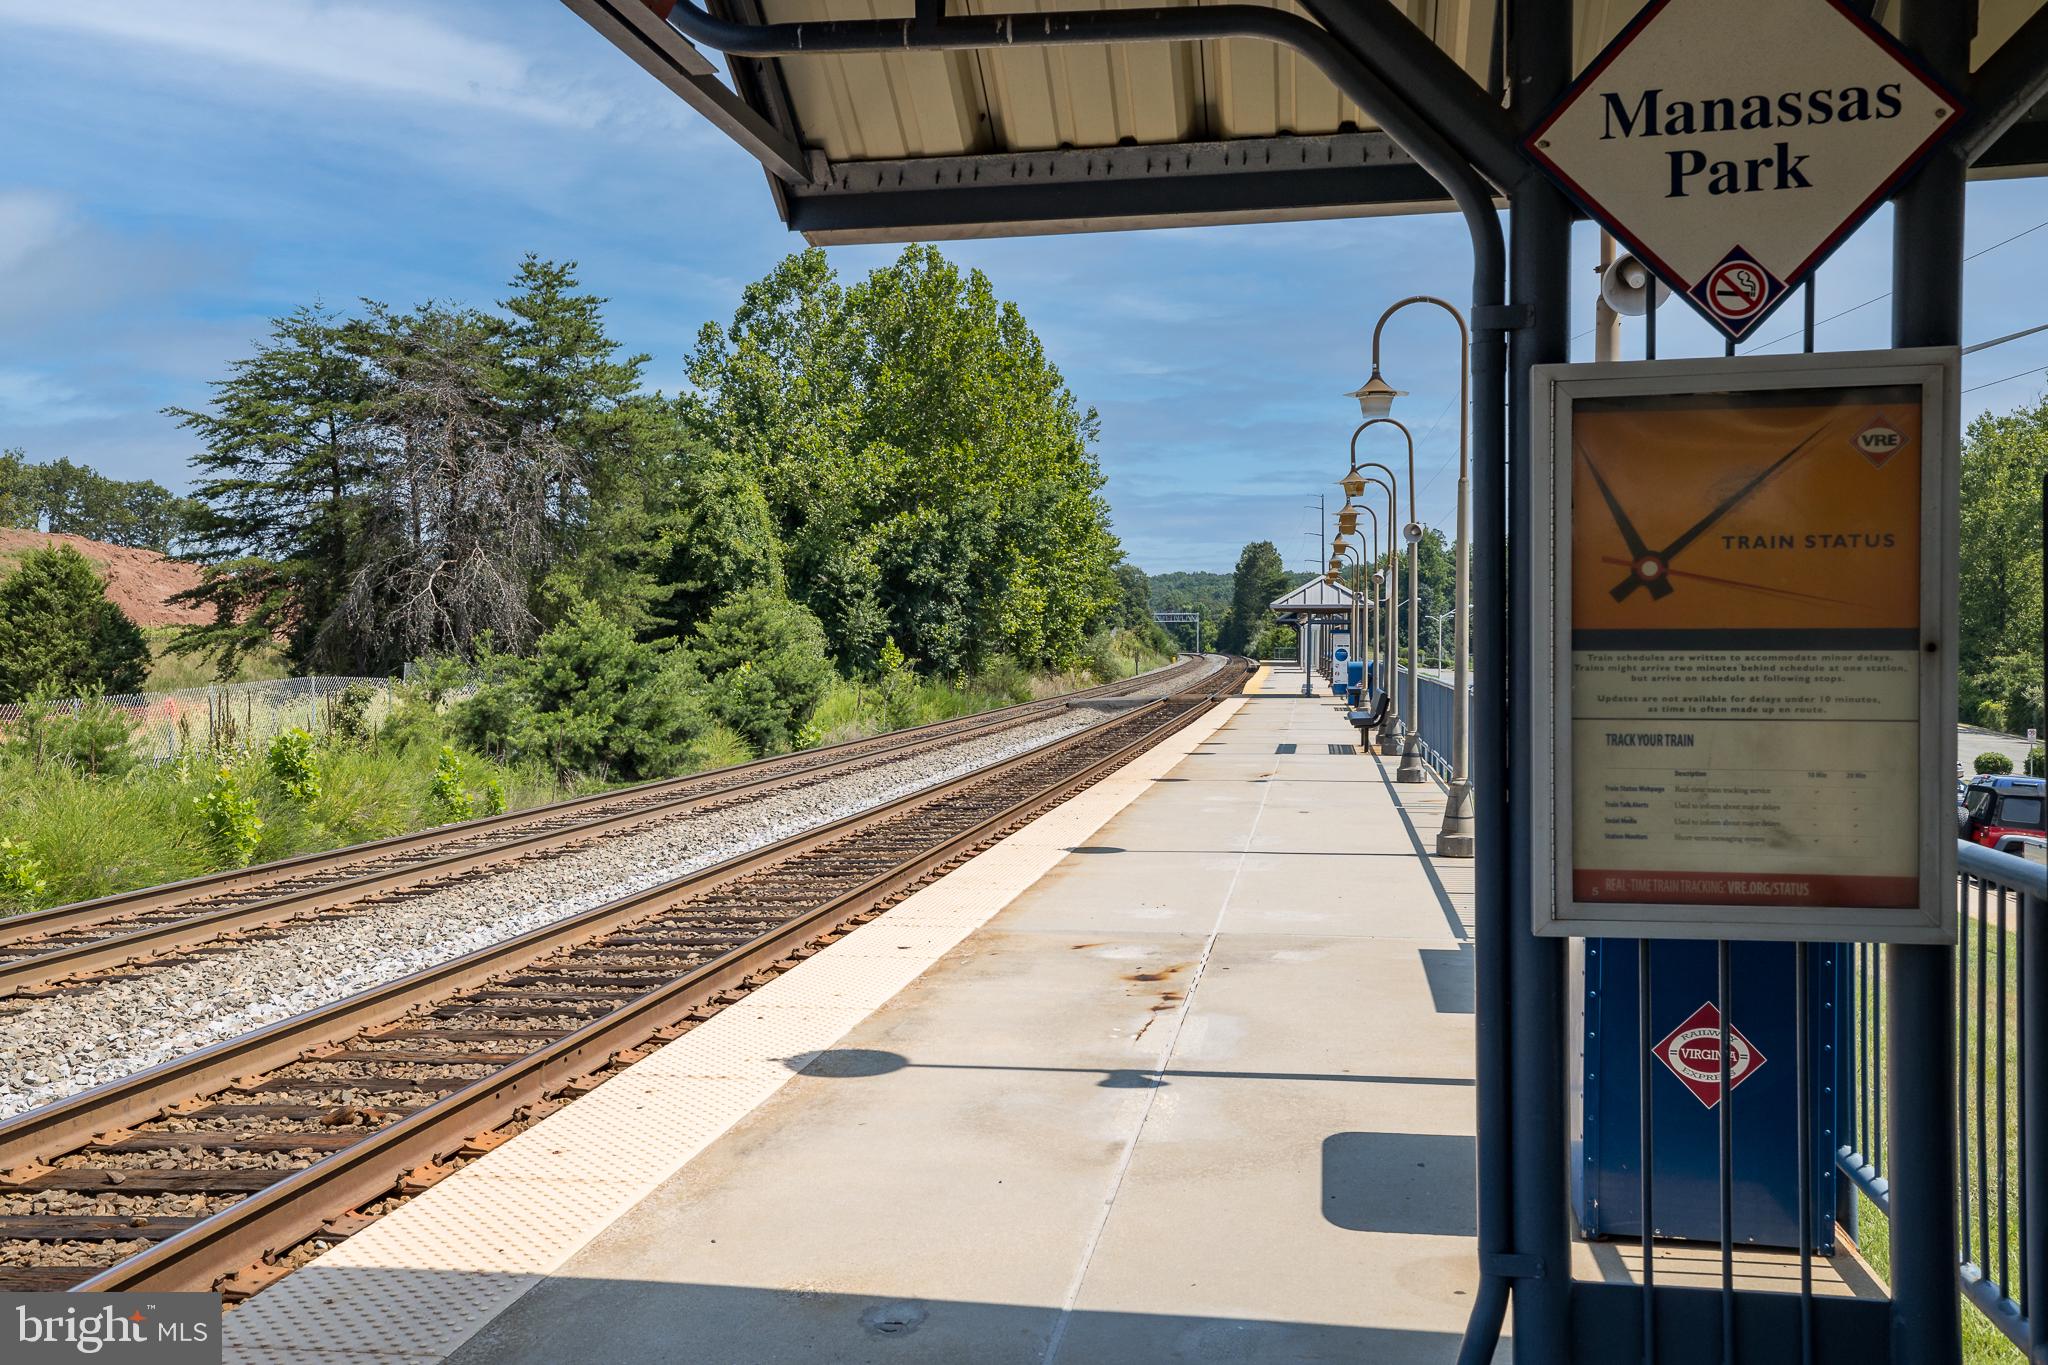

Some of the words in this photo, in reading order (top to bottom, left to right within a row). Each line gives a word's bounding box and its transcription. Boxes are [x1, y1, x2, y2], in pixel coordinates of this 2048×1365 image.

[1599, 82, 1903, 141] Manassas
[1664, 143, 1813, 198] Park
[1860, 434, 1897, 447] VRE
[1722, 535, 1794, 549] TRAIN
[1804, 534, 1895, 549] STATUS
[1587, 654, 1613, 662] Train
[1617, 654, 1665, 662] schedules
[1689, 654, 1727, 662] written
[1745, 654, 1817, 662] accommodate
[1821, 654, 1853, 662] minor
[1574, 664, 1605, 672] Trains
[1608, 664, 1637, 673] might
[1641, 664, 1671, 672] arrive
[1696, 664, 1738, 672] minutes
[1741, 664, 1776, 672] behind
[1779, 664, 1825, 672] schedule
[1763, 675, 1811, 684] following
[1596, 695, 1638, 705] Updates
[1682, 695, 1727, 703] available
[1730, 695, 1746, 703] for
[1749, 695, 1781, 704] delays
[1784, 695, 1815, 703] under
[1820, 695, 1831, 703] 10
[1762, 707, 1775, 715] up
[1605, 733, 1635, 746] TRACK
[1637, 733, 1663, 746] YOUR
[1664, 733, 1694, 746] TRAIN
[1653, 879, 1680, 894] TRAIN
[1680, 880, 1727, 895] TRACKING:
[1727, 881, 1810, 896] VRE.ORG/STATUS
